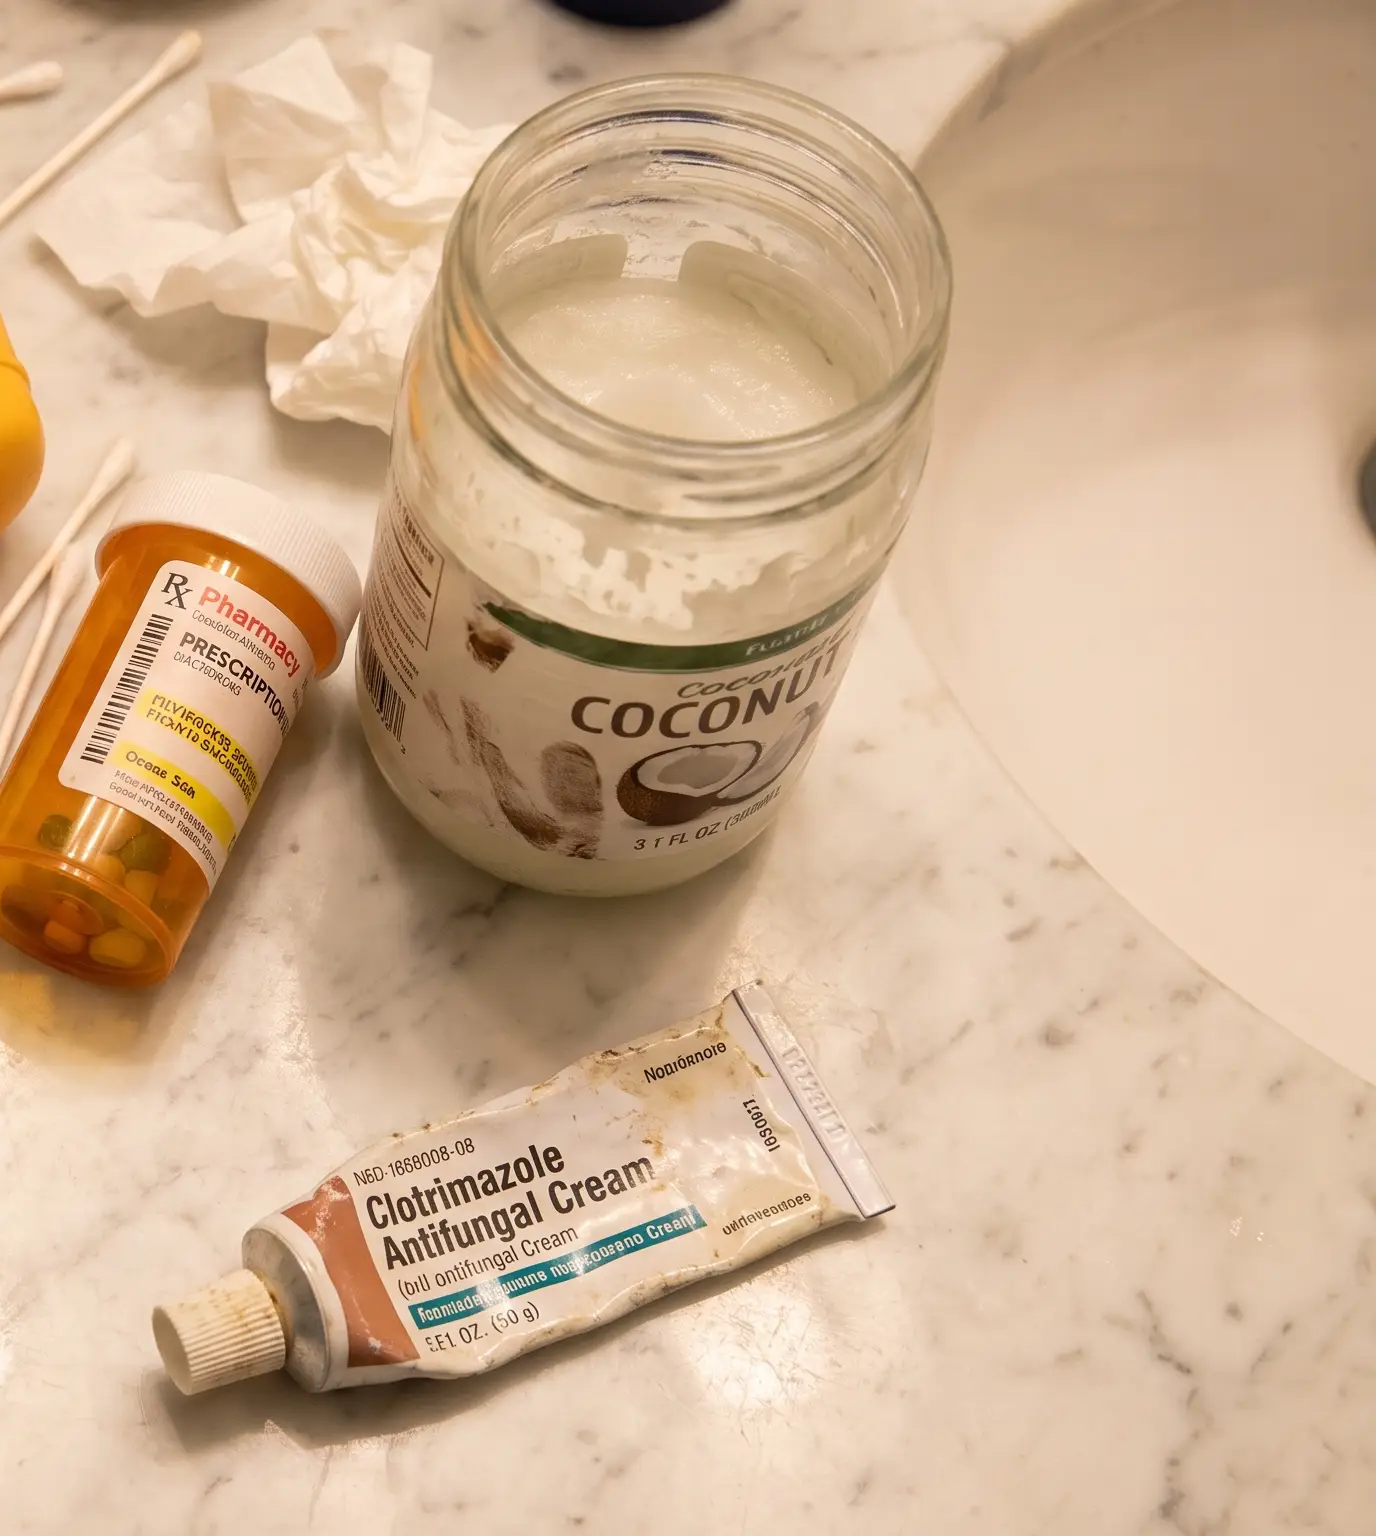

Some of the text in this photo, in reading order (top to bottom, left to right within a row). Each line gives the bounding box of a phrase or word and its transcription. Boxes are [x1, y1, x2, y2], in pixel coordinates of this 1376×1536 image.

[198, 586, 302, 678] Pharmacy
[570, 629, 848, 740] COCONUT
[633, 838, 647, 851] 3
[668, 832, 689, 846] FL
[694, 821, 722, 840] OZ
[366, 1144, 565, 1230] Clotrimazole
[382, 1190, 544, 1271] Antifungal
[548, 1157, 653, 1215] Cream
[520, 1227, 579, 1257] Cream
[522, 1301, 540, 1323] g)
